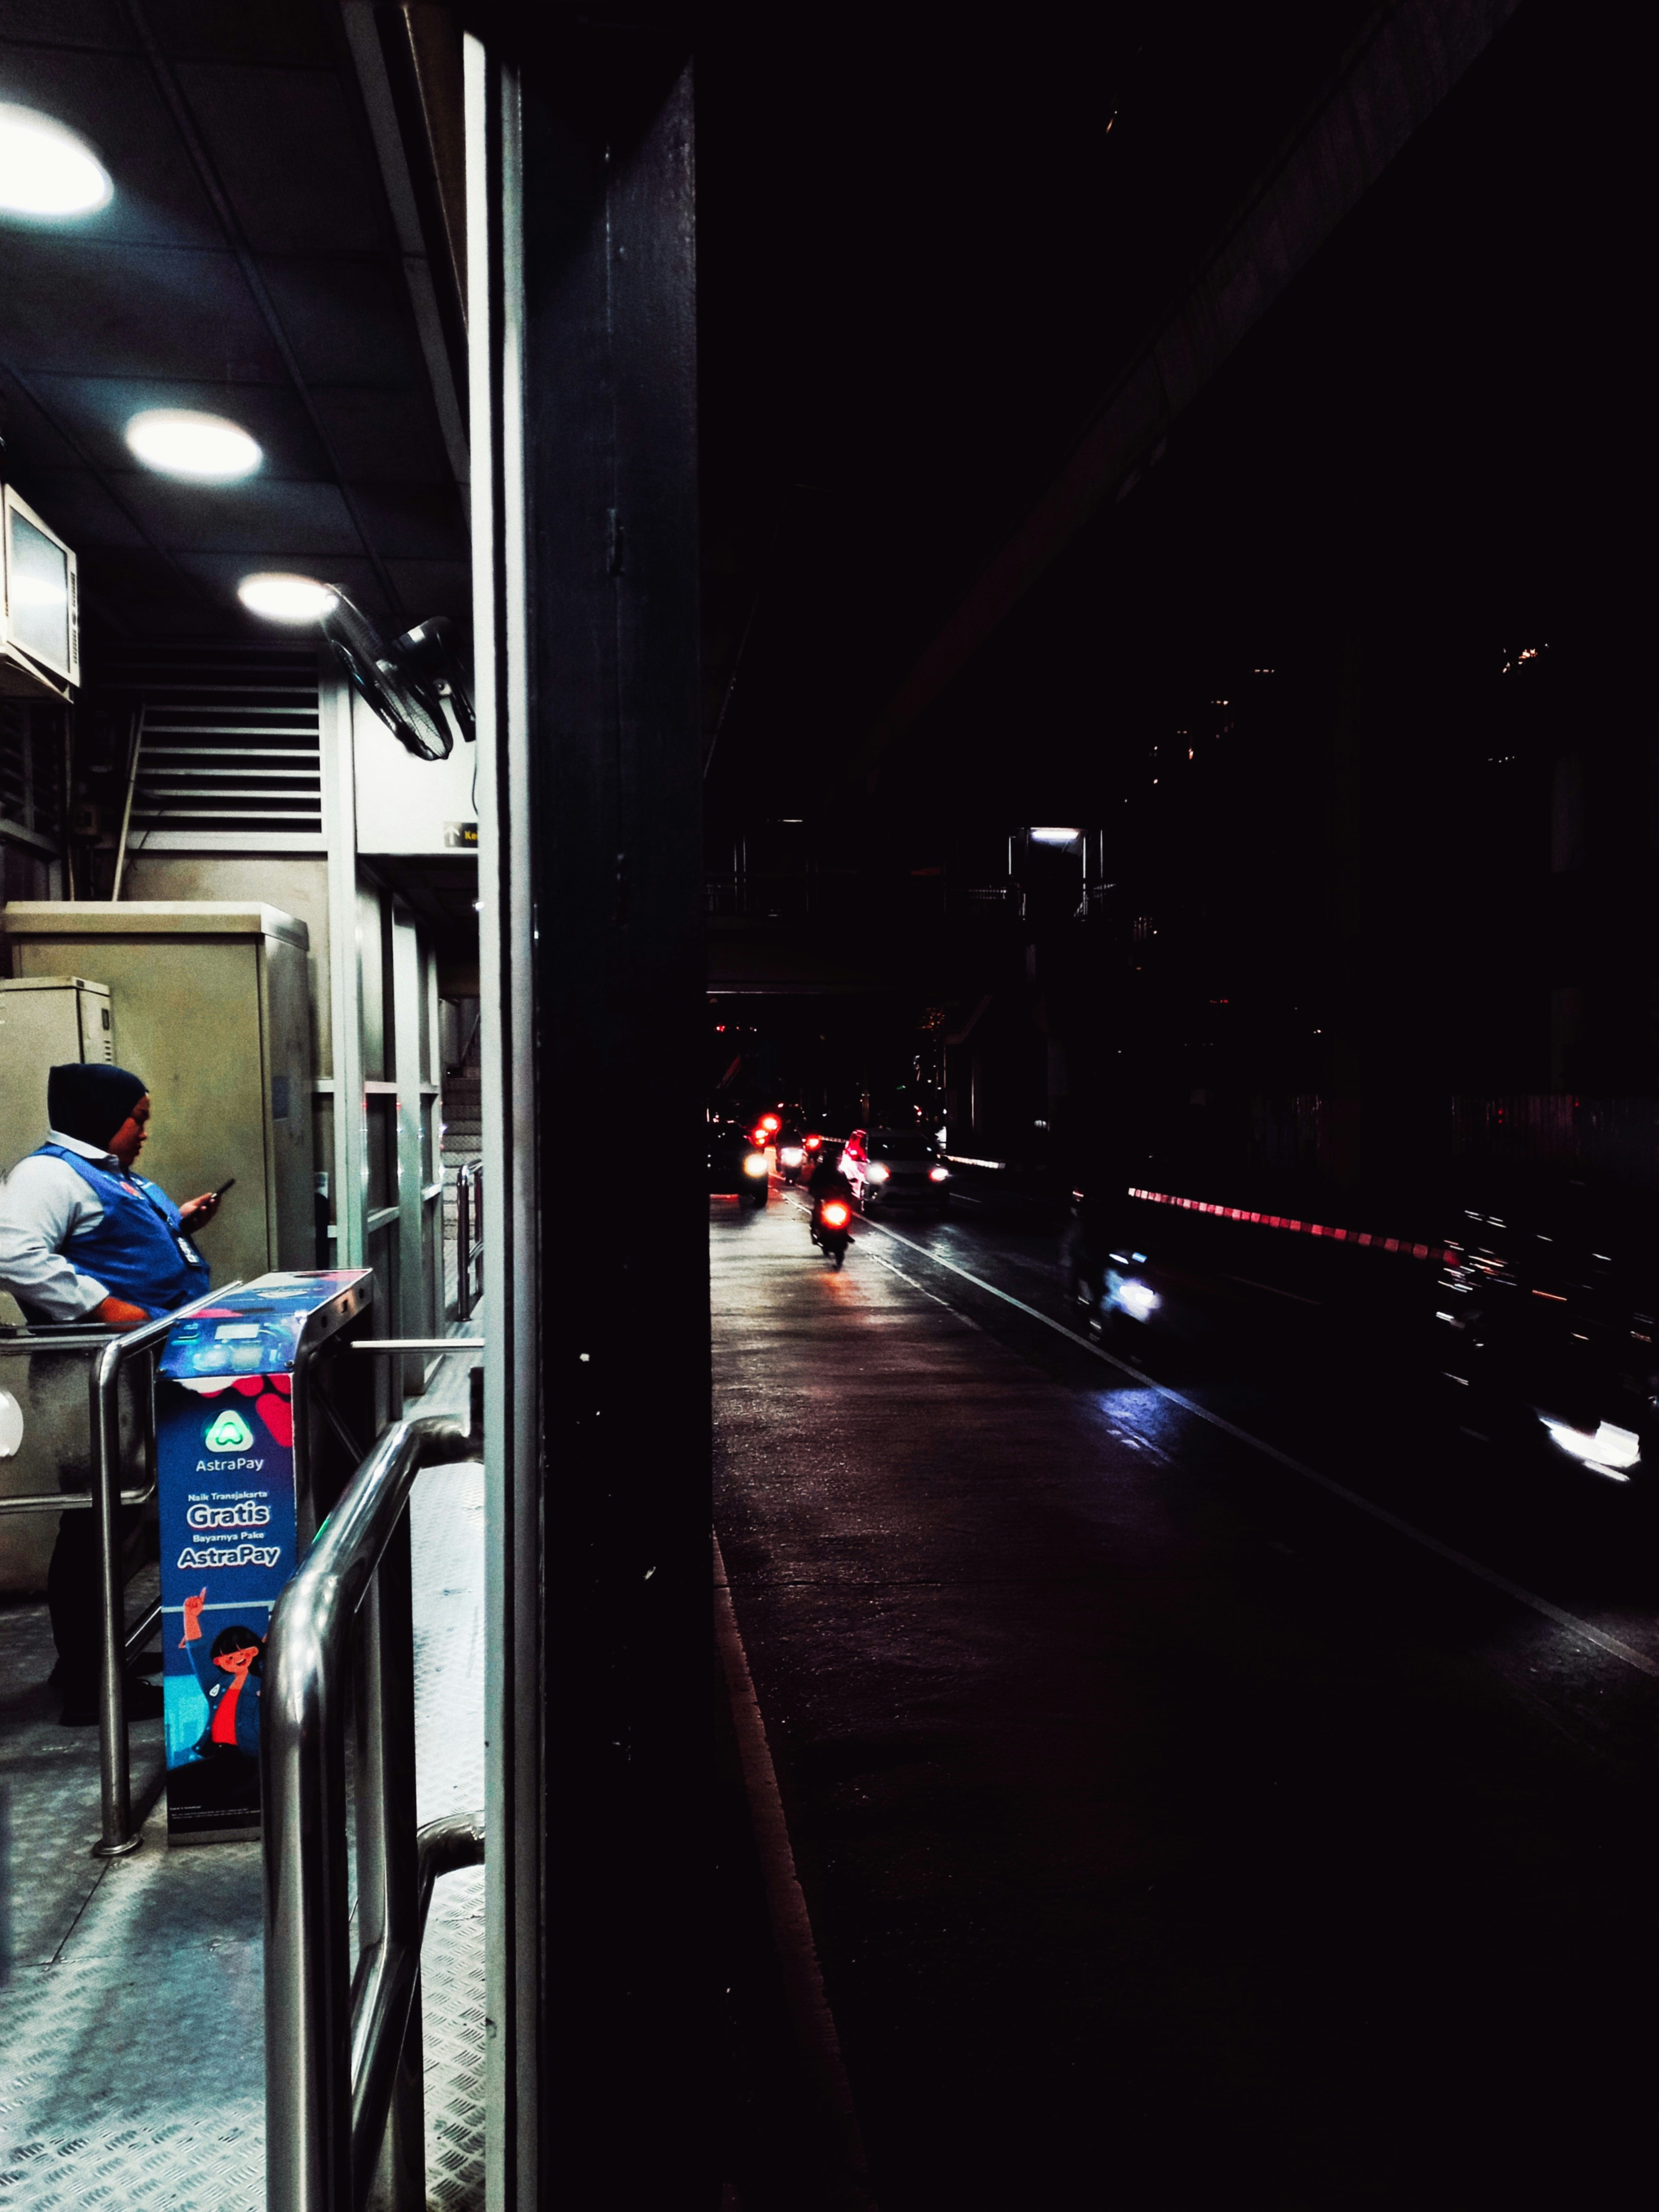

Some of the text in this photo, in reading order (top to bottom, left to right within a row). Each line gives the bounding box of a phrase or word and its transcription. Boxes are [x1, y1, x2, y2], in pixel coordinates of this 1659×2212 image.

[464, 831, 478, 840] Ke
[196, 1458, 264, 1471] AstraPay
[211, 1491, 268, 1500] Transjakarta
[193, 1535, 238, 1543] Bayarnya
[178, 1544, 280, 1568] AstraPay
